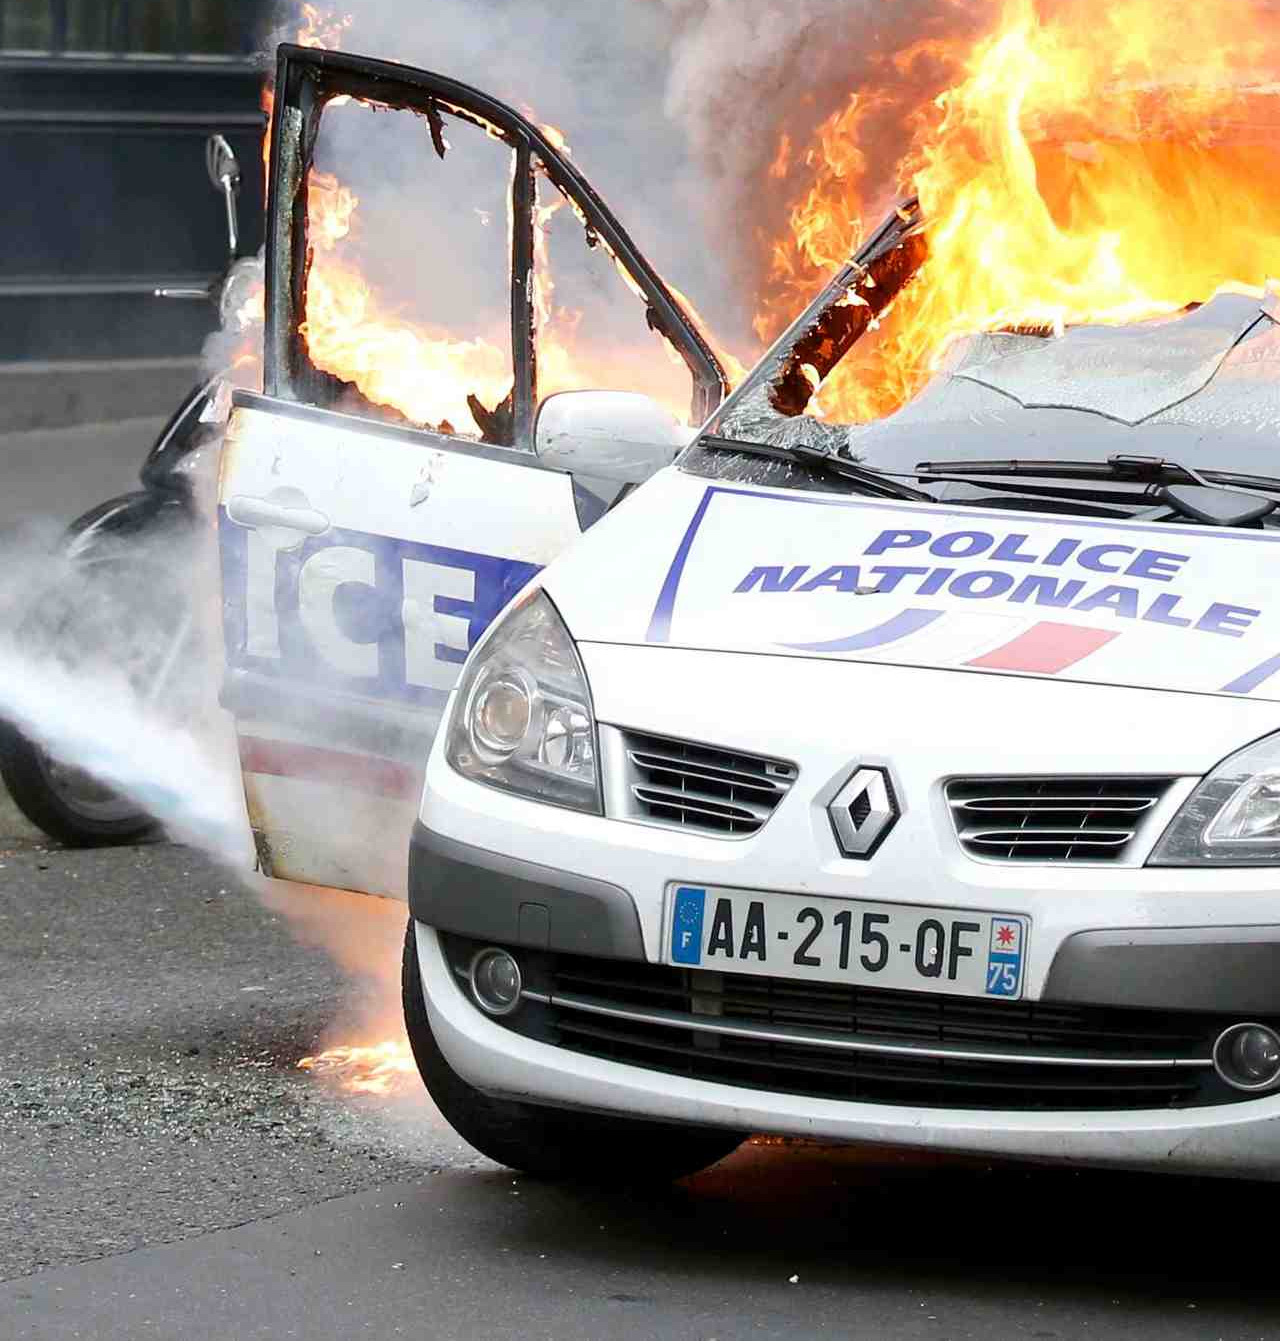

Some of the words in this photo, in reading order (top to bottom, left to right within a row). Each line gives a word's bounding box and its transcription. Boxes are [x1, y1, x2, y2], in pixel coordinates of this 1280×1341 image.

[863, 529, 1191, 583] POLICE
[733, 565, 1261, 638] NATIONALE
[680, 932, 693, 950] F
[706, 898, 980, 981] AA-215-QF
[989, 962, 1017, 993] 75
